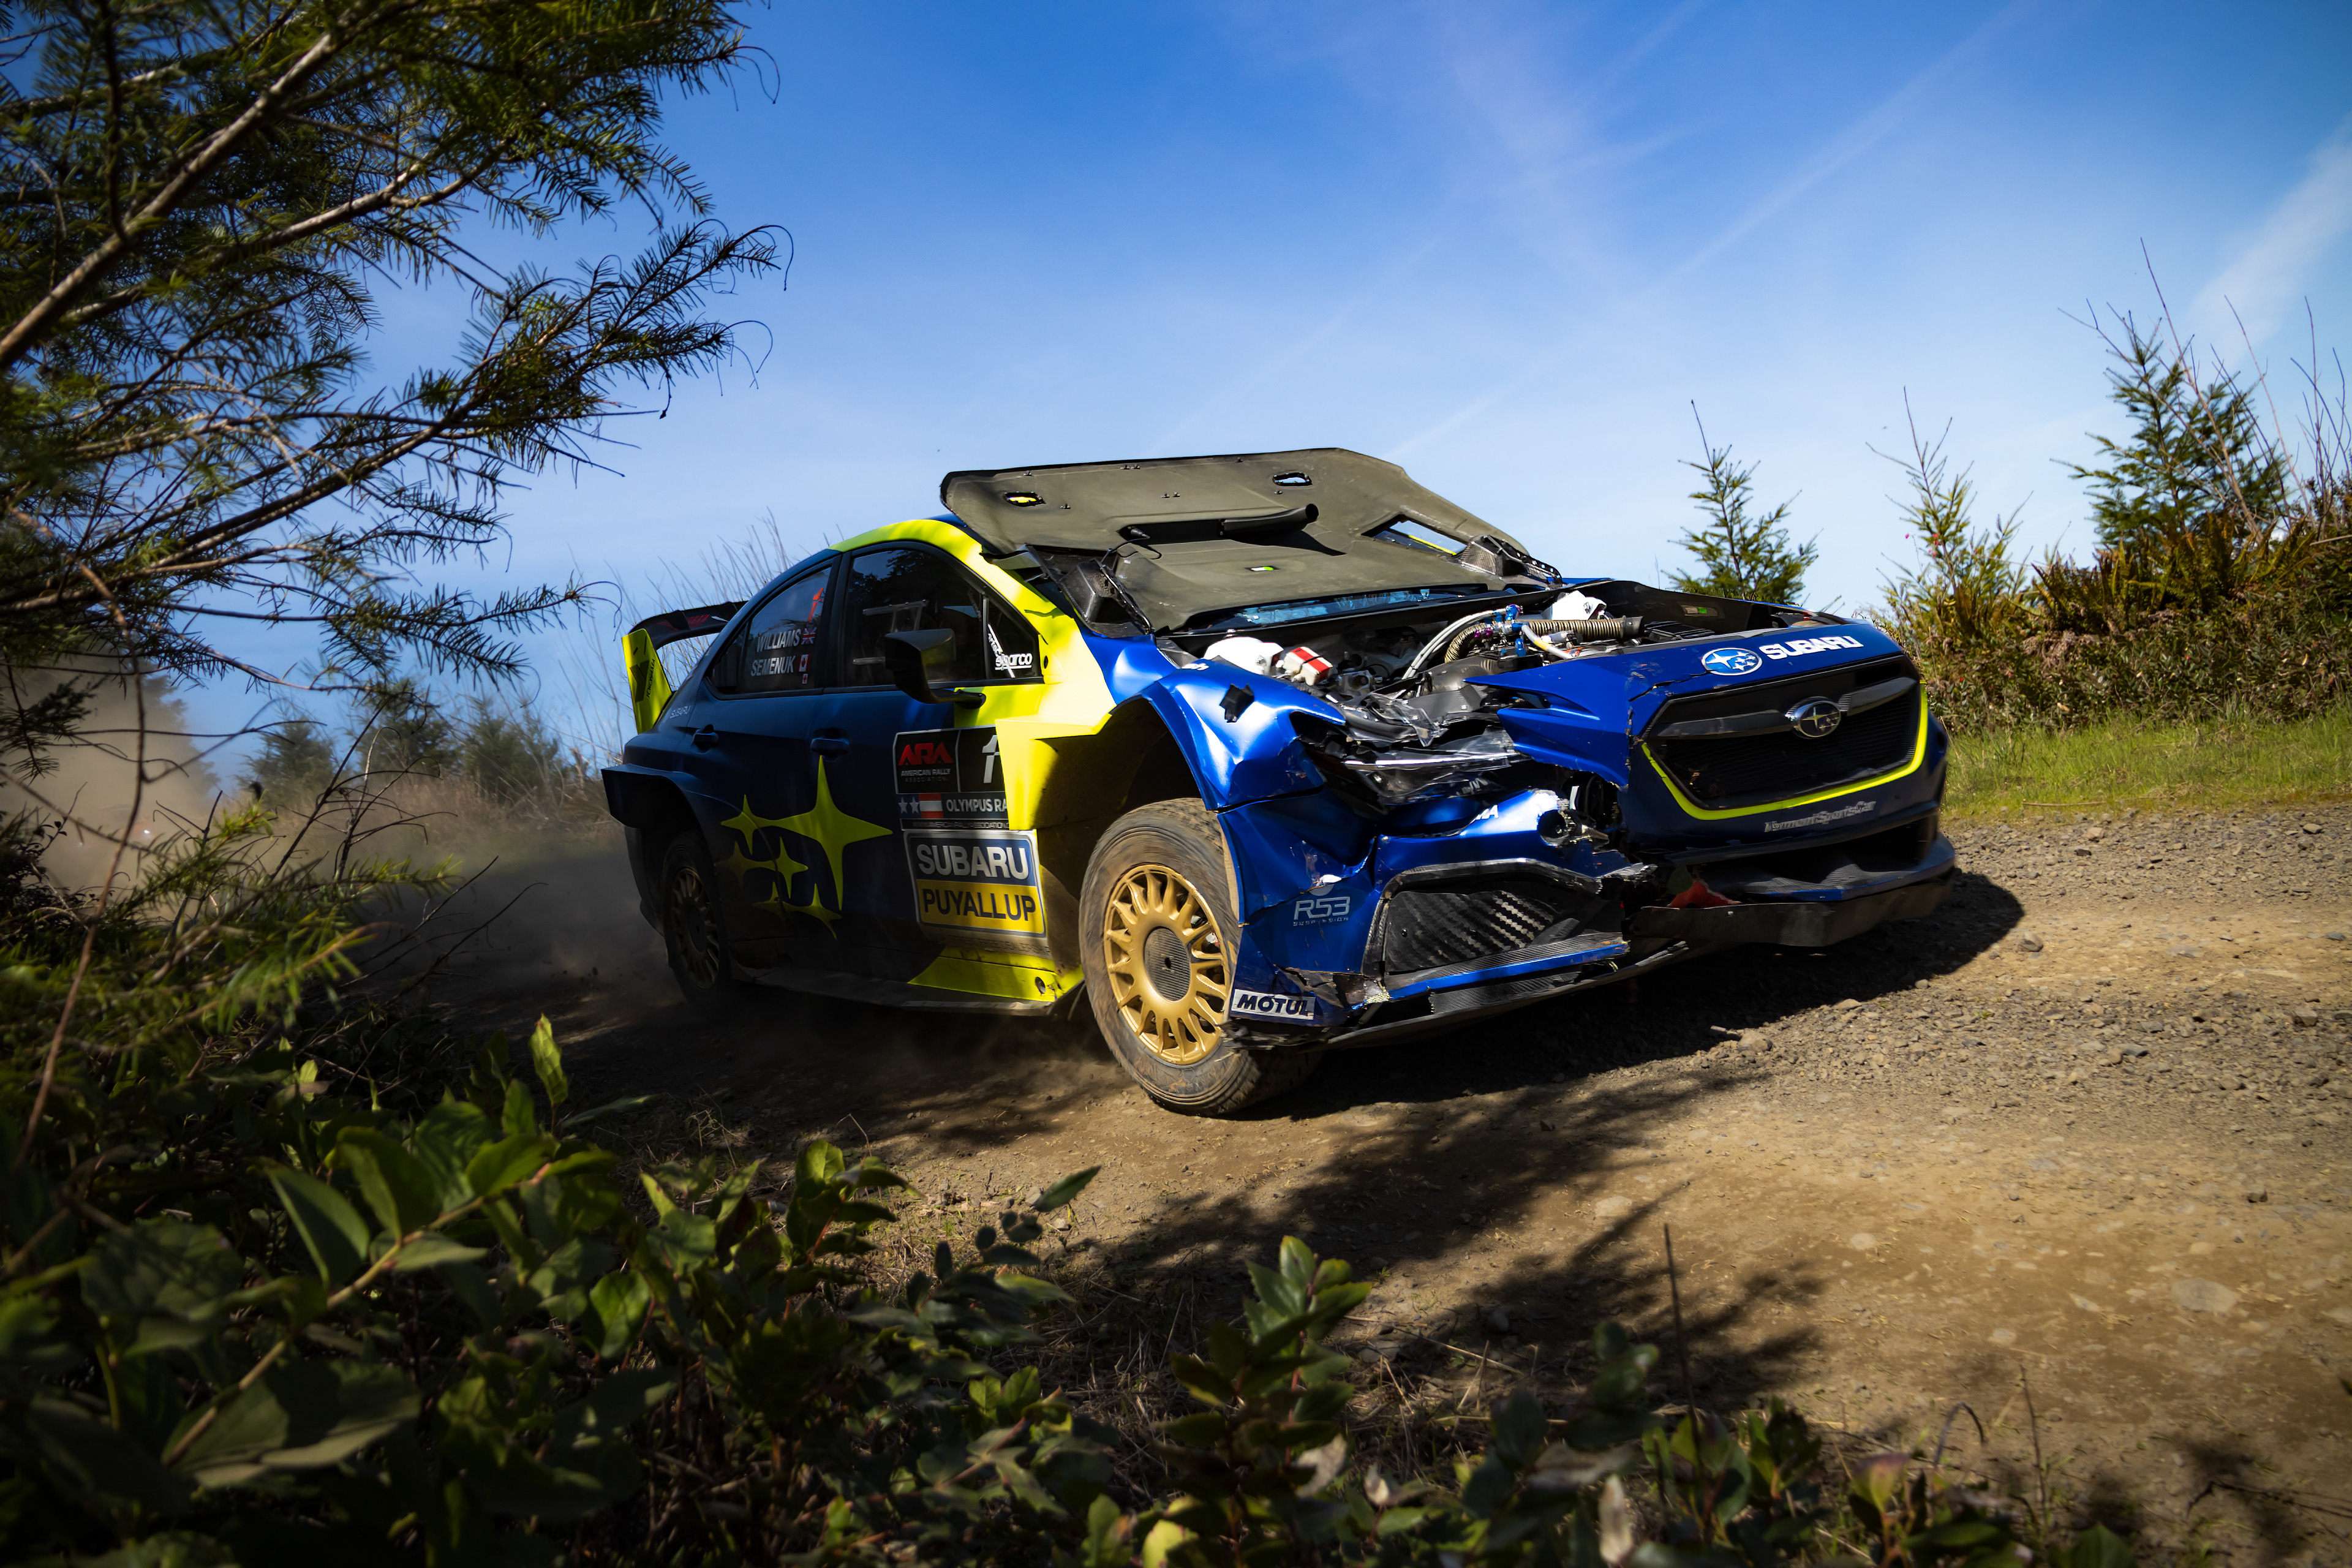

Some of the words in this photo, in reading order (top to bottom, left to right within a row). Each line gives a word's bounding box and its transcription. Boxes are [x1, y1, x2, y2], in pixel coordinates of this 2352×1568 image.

[757, 629, 801, 652] WILLIAMS
[1759, 636, 1864, 660] SUBARU
[751, 655, 796, 677] SEMENUK
[899, 742, 954, 766] ARA
[946, 799, 993, 812] OLYMPUS
[917, 845, 1029, 880] SUBARU
[922, 889, 1036, 921] PUYALLUP
[1294, 897, 1351, 920] R53
[1237, 994, 1314, 1017] MOTUL
